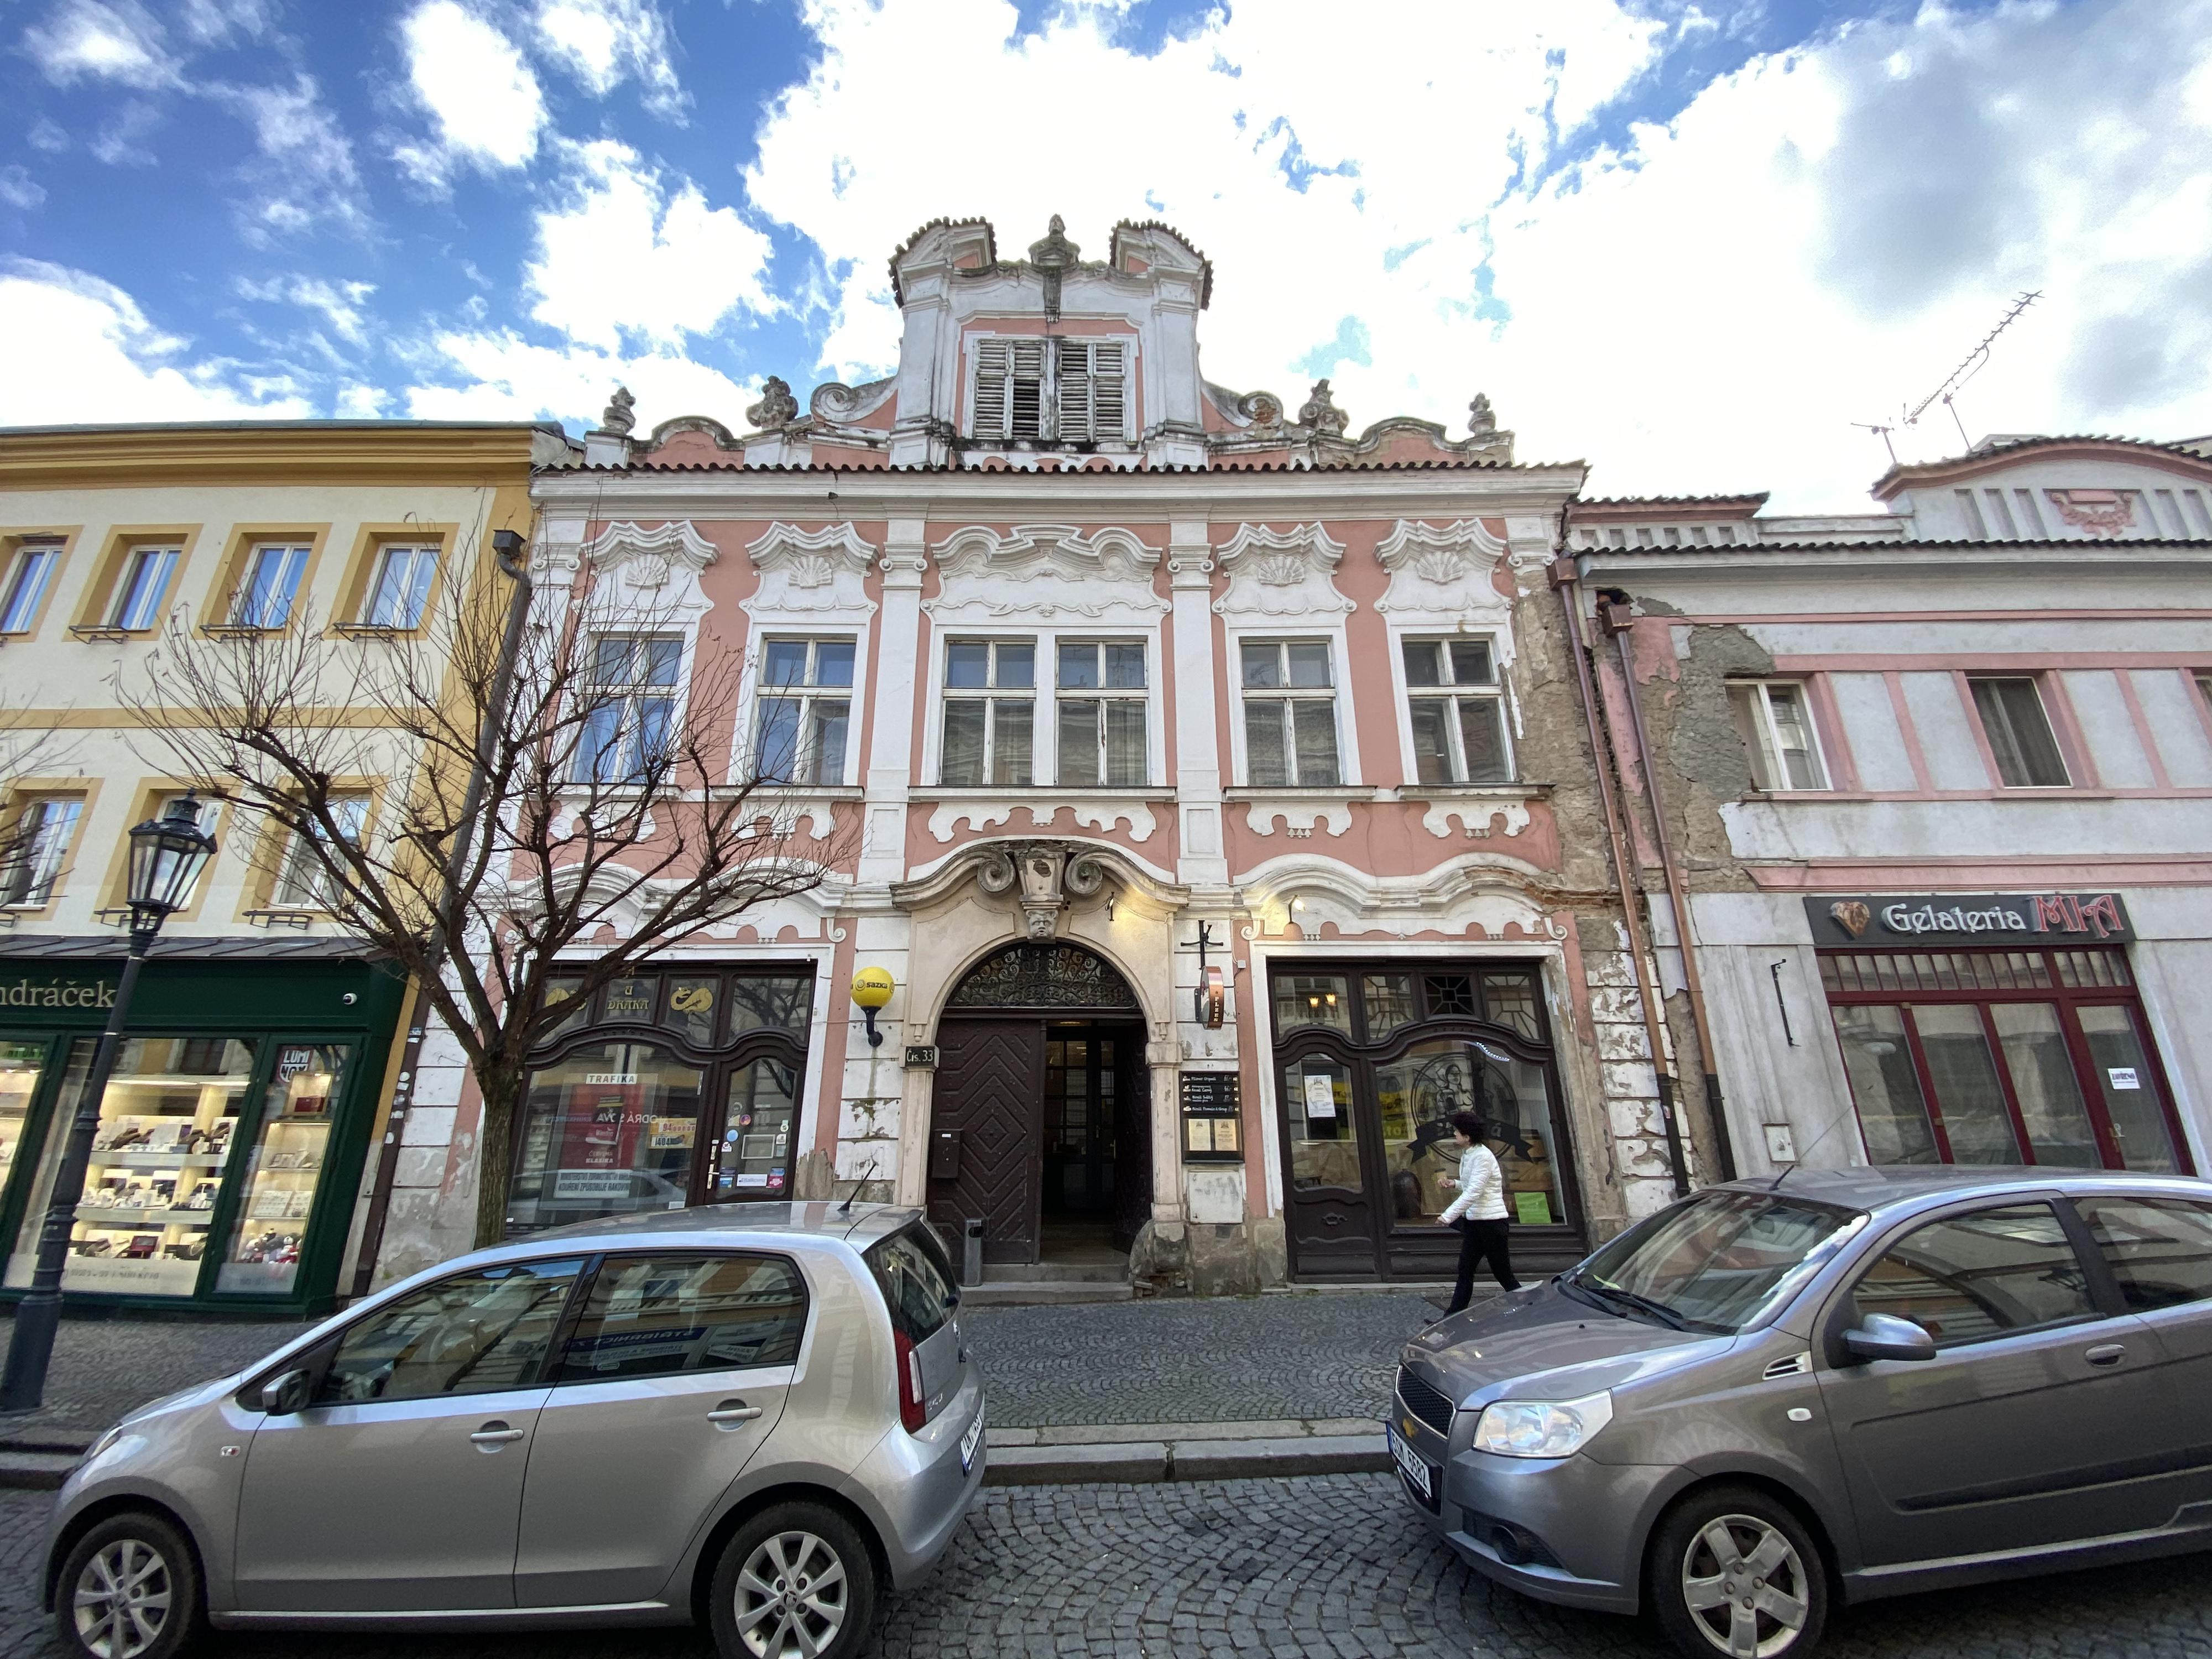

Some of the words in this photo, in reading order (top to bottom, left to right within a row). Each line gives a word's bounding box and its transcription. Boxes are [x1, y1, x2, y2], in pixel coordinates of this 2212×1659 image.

[1882, 902, 2027, 934] Gelateria
[2032, 894, 2124, 938] MIA
[607, 1000, 649, 1010] DRAKA
[922, 1050, 933, 1062] 33
